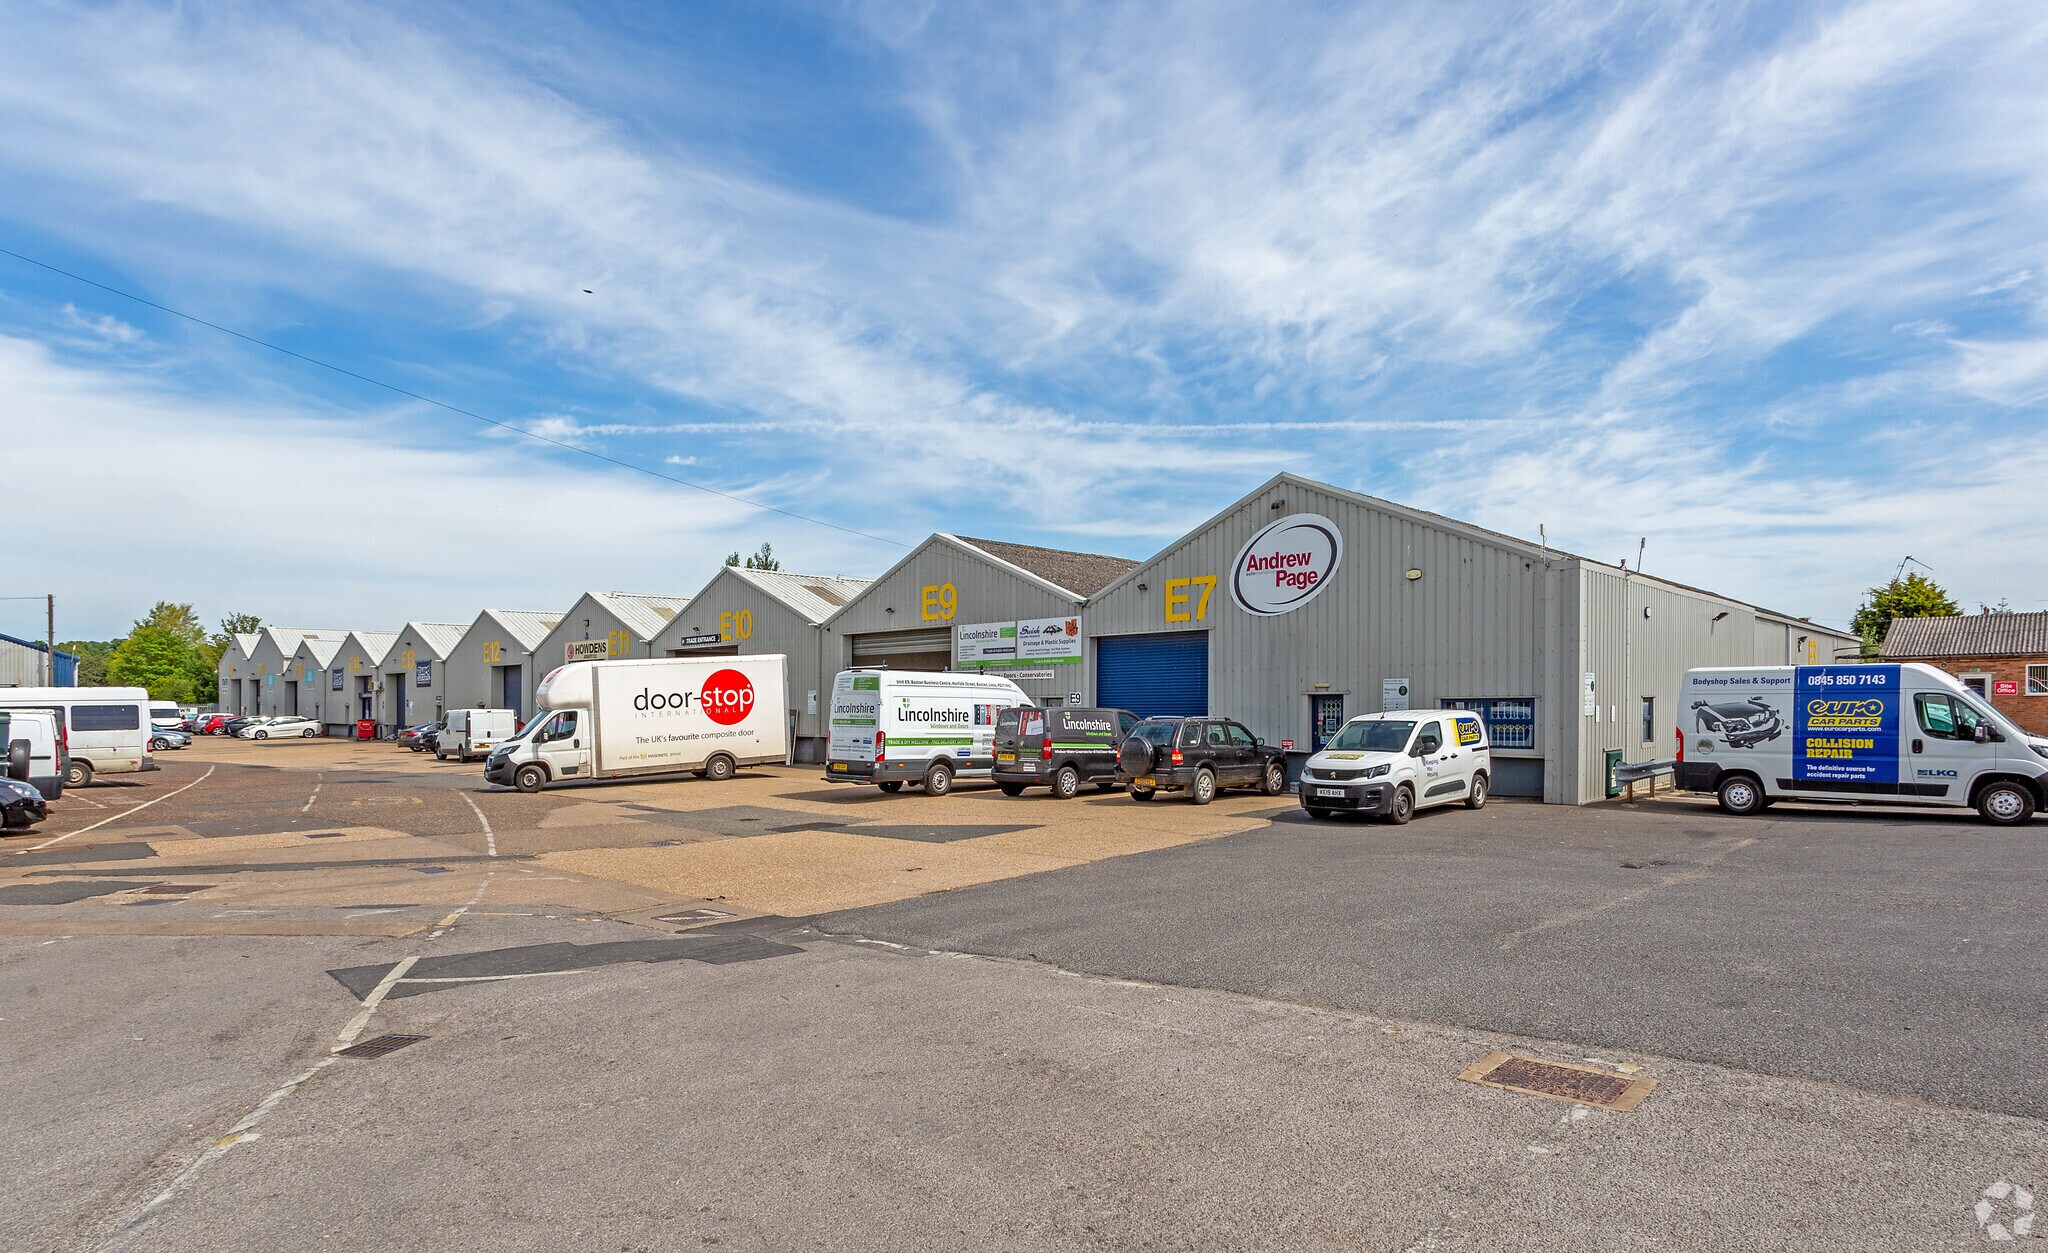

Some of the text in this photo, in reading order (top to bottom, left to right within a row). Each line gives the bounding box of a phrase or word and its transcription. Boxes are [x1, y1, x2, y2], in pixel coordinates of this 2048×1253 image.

[1246, 552, 1312, 571] Andrew
[1276, 570, 1318, 590] Page
[921, 583, 958, 621] E9
[1165, 575, 1217, 622] E7
[720, 609, 753, 641] E10
[1019, 625, 1041, 635] Swish
[697, 635, 716, 643] ENTRANCE
[959, 629, 998, 640] Lincolnshire
[575, 642, 607, 655] HOWDENS
[608, 629, 630, 656] E11
[483, 640, 501, 663] E12
[1019, 671, 1053, 679] Conservatories
[1692, 678, 1728, 686] Bodyshop
[1761, 677, 1791, 685] Support
[1808, 674, 1886, 685] 0845 850 7143
[634, 686, 754, 712] door-stop
[1070, 693, 1080, 703] E9
[635, 707, 736, 719] INTERNATIONAL
[834, 702, 875, 714] Lincolnshire
[1807, 699, 1884, 716] euro
[898, 707, 969, 722] Lincolnshire
[1062, 717, 1112, 731] Lincolnshire
[1458, 721, 1479, 735] euro
[635, 729, 755, 744] The UK's favourite composite door
[1806, 738, 1874, 749] COLLISION
[1806, 748, 1853, 759] REPAIR
[1928, 769, 1958, 777] LKQ
